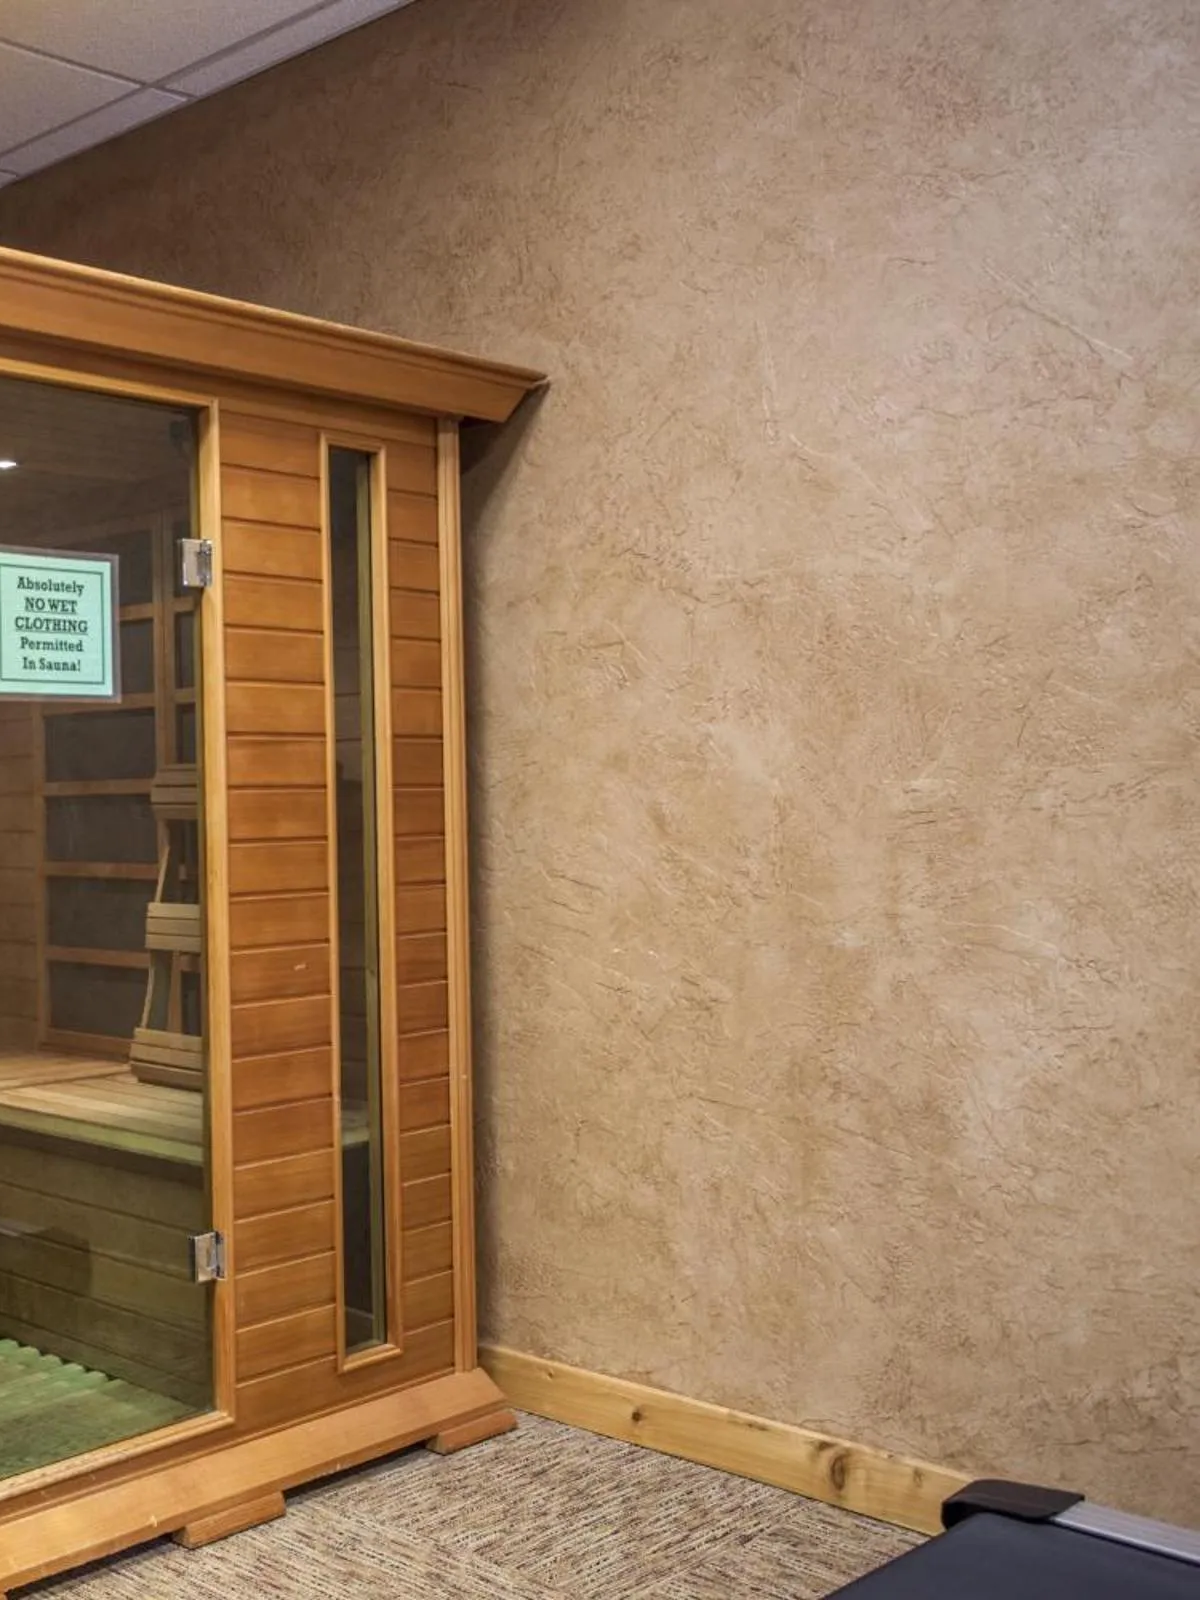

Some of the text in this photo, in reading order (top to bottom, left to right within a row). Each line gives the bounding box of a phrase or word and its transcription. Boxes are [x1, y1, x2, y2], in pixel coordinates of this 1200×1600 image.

[17, 576, 85, 597] Absolutely
[24, 597, 78, 613] NO WET
[15, 616, 89, 633] CLOTHING
[20, 637, 84, 652] Permitted
[23, 657, 81, 672] In Sauna!
